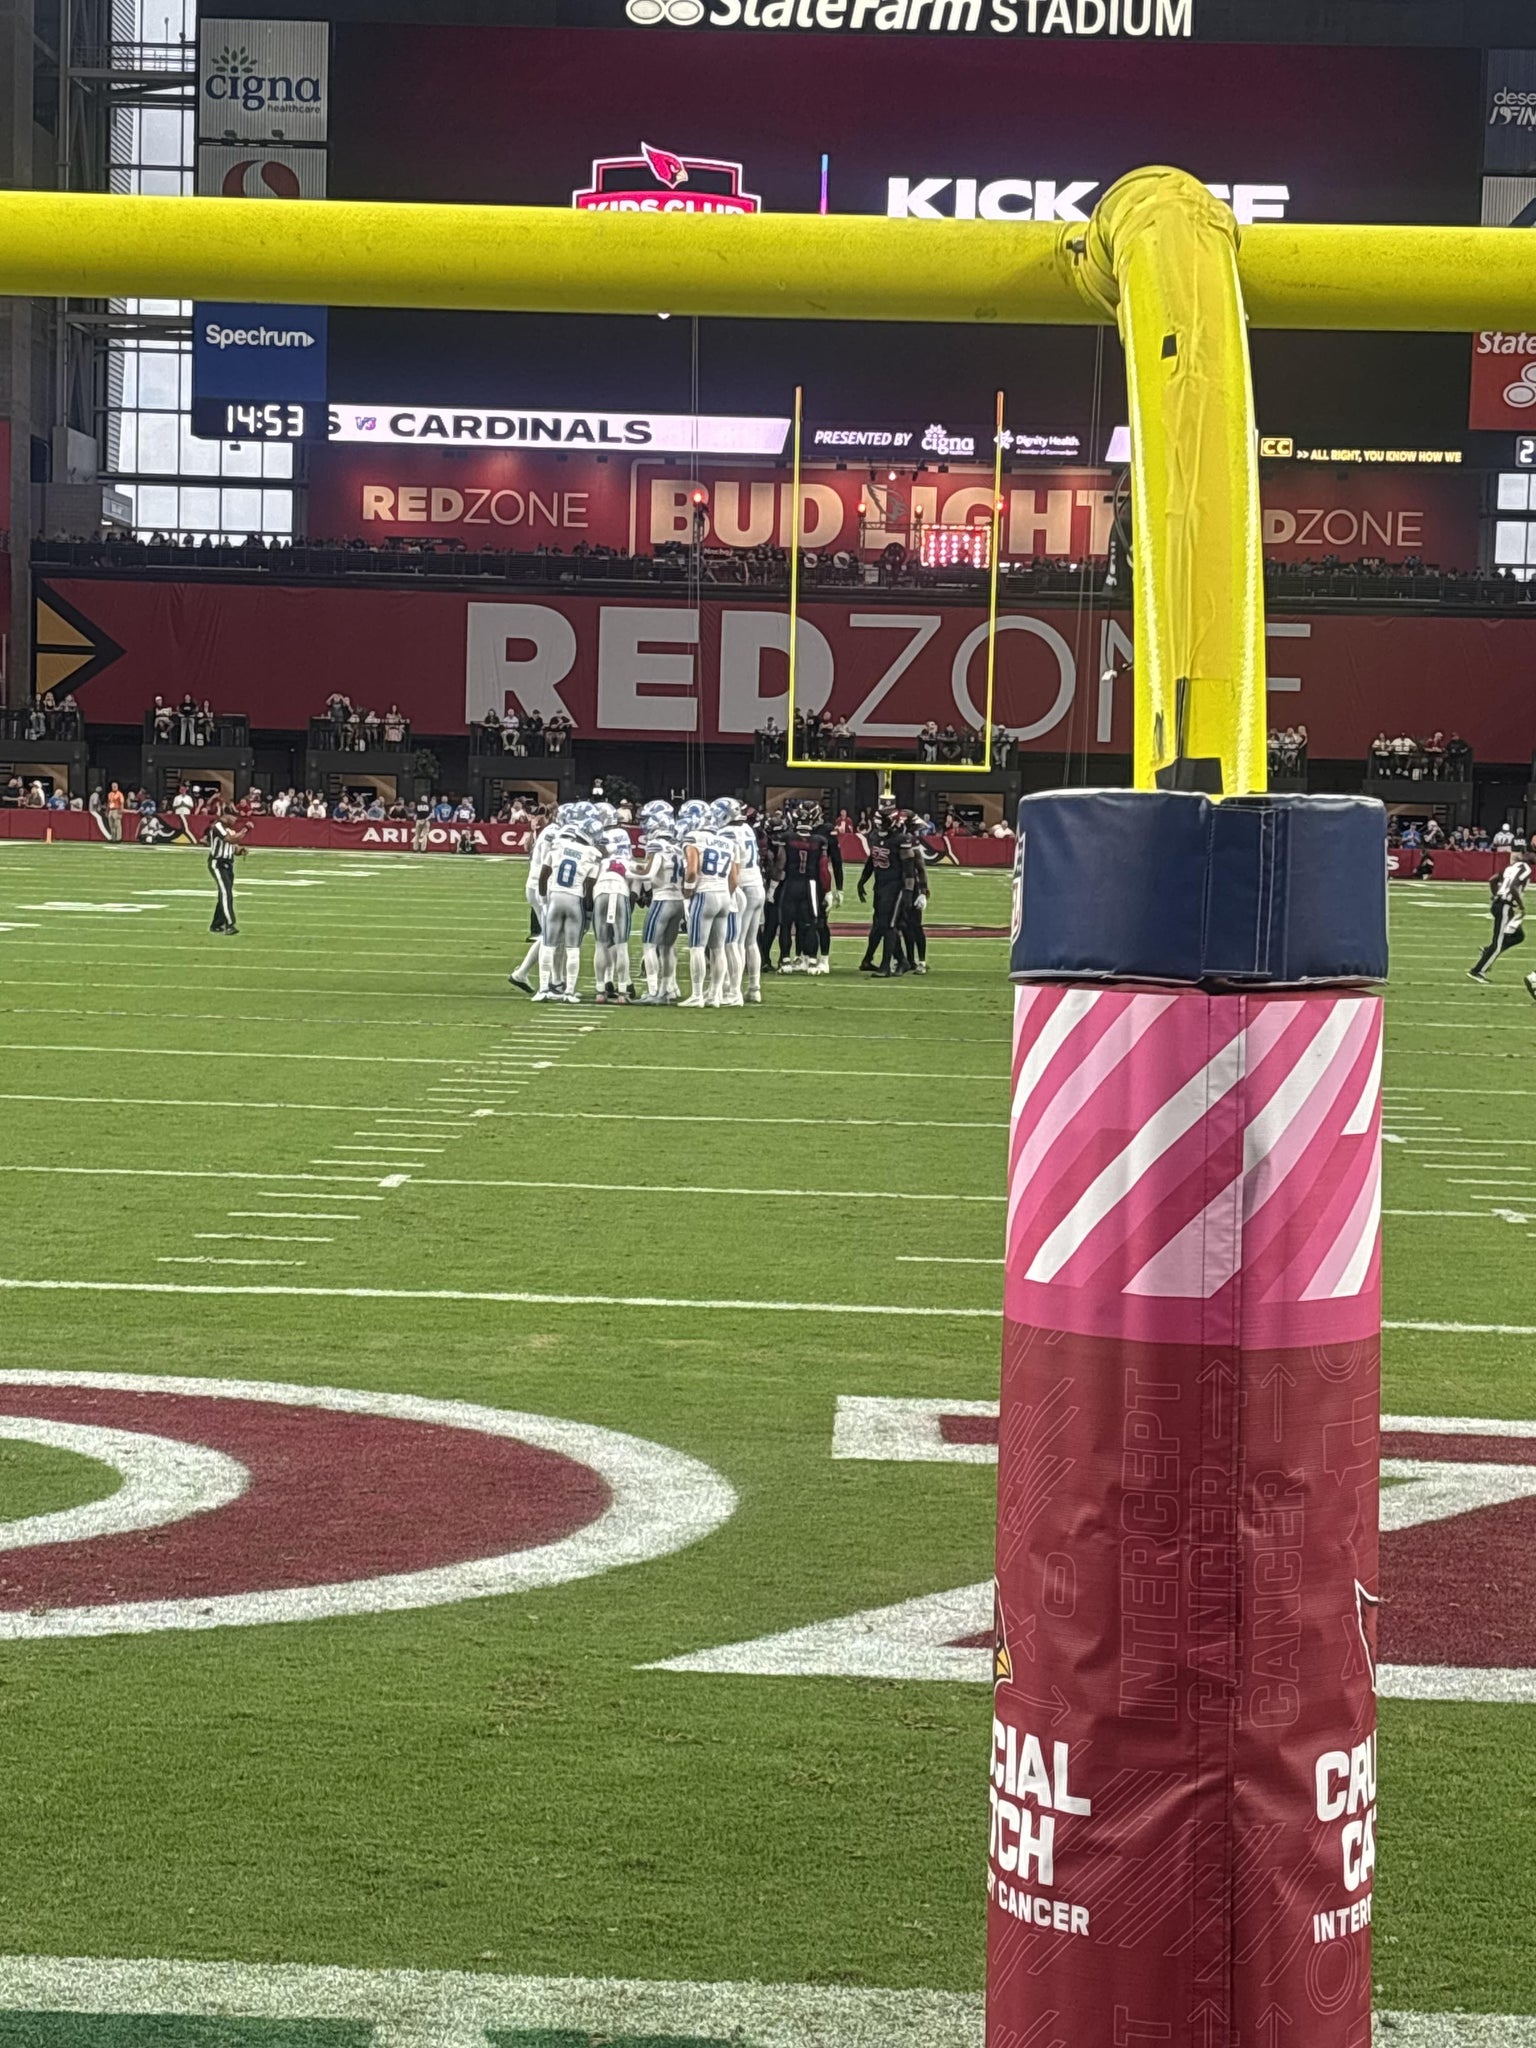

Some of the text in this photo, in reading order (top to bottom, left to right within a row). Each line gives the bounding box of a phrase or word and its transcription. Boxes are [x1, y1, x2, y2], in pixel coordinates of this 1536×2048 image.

[709, 0, 1193, 37] StateFarm STADIUM
[205, 74, 321, 111] cigna
[267, 104, 321, 113] healthcare
[887, 177, 1290, 225] KICKF
[205, 324, 308, 350] Spectrum
[227, 404, 304, 437] 14:53
[389, 413, 653, 445] CARDINALS
[814, 430, 913, 447] PRESENTED BY
[921, 437, 975, 455] cigna
[1016, 435, 1080, 448] Dignity Health
[1263, 440, 1290, 455] CC
[1310, 449, 1329, 461] ALL
[1331, 450, 1362, 464] RIGHT,
[1364, 451, 1384, 462] YOU
[1386, 451, 1418, 462] KNOW
[1419, 452, 1444, 463] HOW
[1445, 452, 1462, 463] WE
[362, 485, 590, 529] REDZONE
[650, 478, 1128, 557] BUD LIGHT
[1265, 508, 1425, 548] DZONE
[464, 602, 1311, 744] REDZO
[557, 859, 577, 888] 0
[702, 848, 732, 878] 87
[1119, 1368, 1180, 1721] INTERCEPT
[1187, 1465, 1239, 1725] CANCER
[1250, 1467, 1305, 1728] CANCER
[990, 1716, 1091, 1816] CIAL
[998, 1880, 1090, 1936] CANCER
